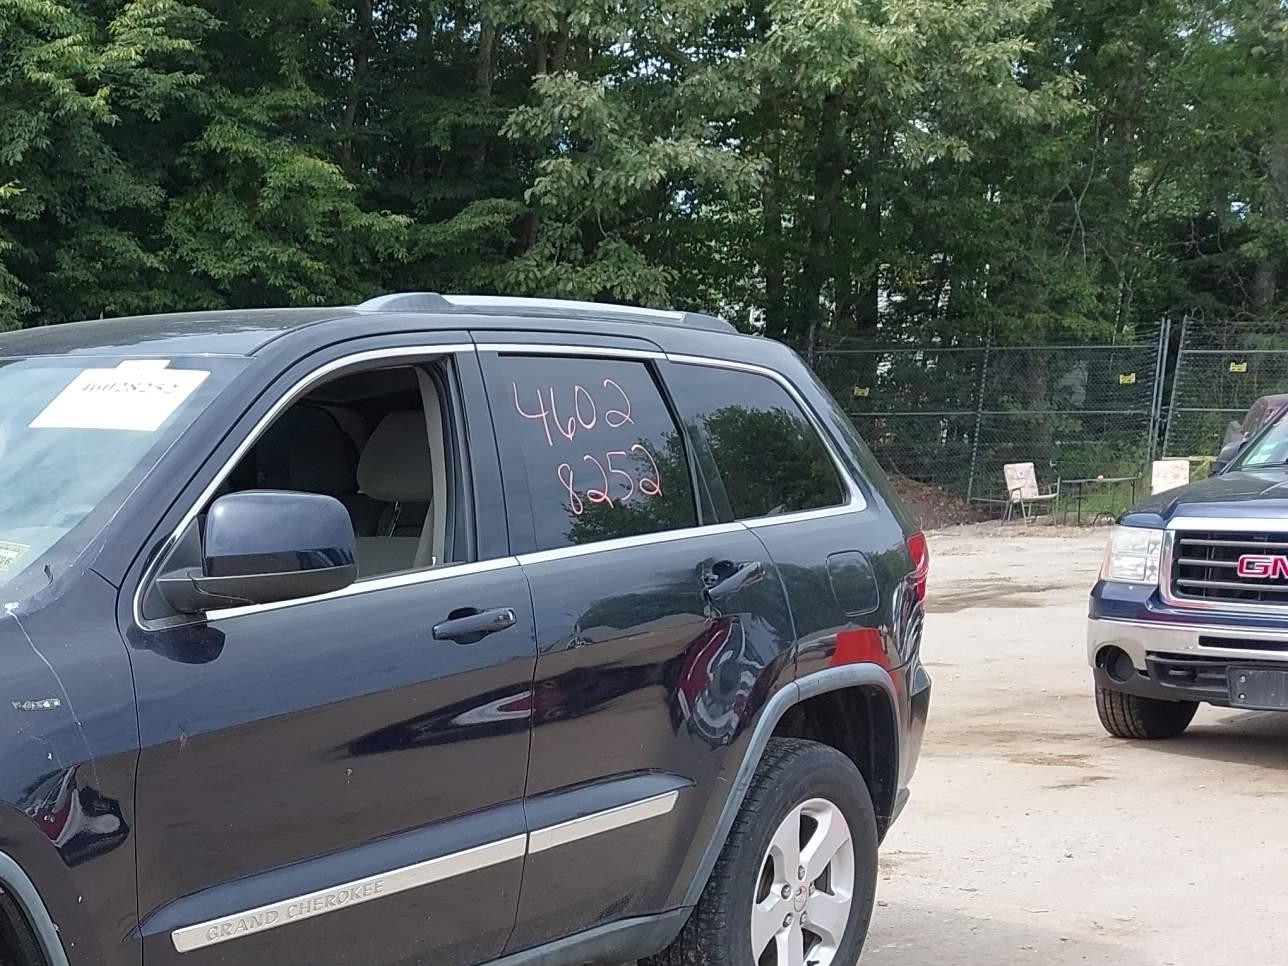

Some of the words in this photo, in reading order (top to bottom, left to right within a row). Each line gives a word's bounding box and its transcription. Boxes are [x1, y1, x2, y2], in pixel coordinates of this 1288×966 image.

[512, 378, 635, 447] 4602
[557, 443, 663, 516] 8252
[206, 909, 279, 942] GRAND
[287, 879, 385, 919] CHEROKEE
